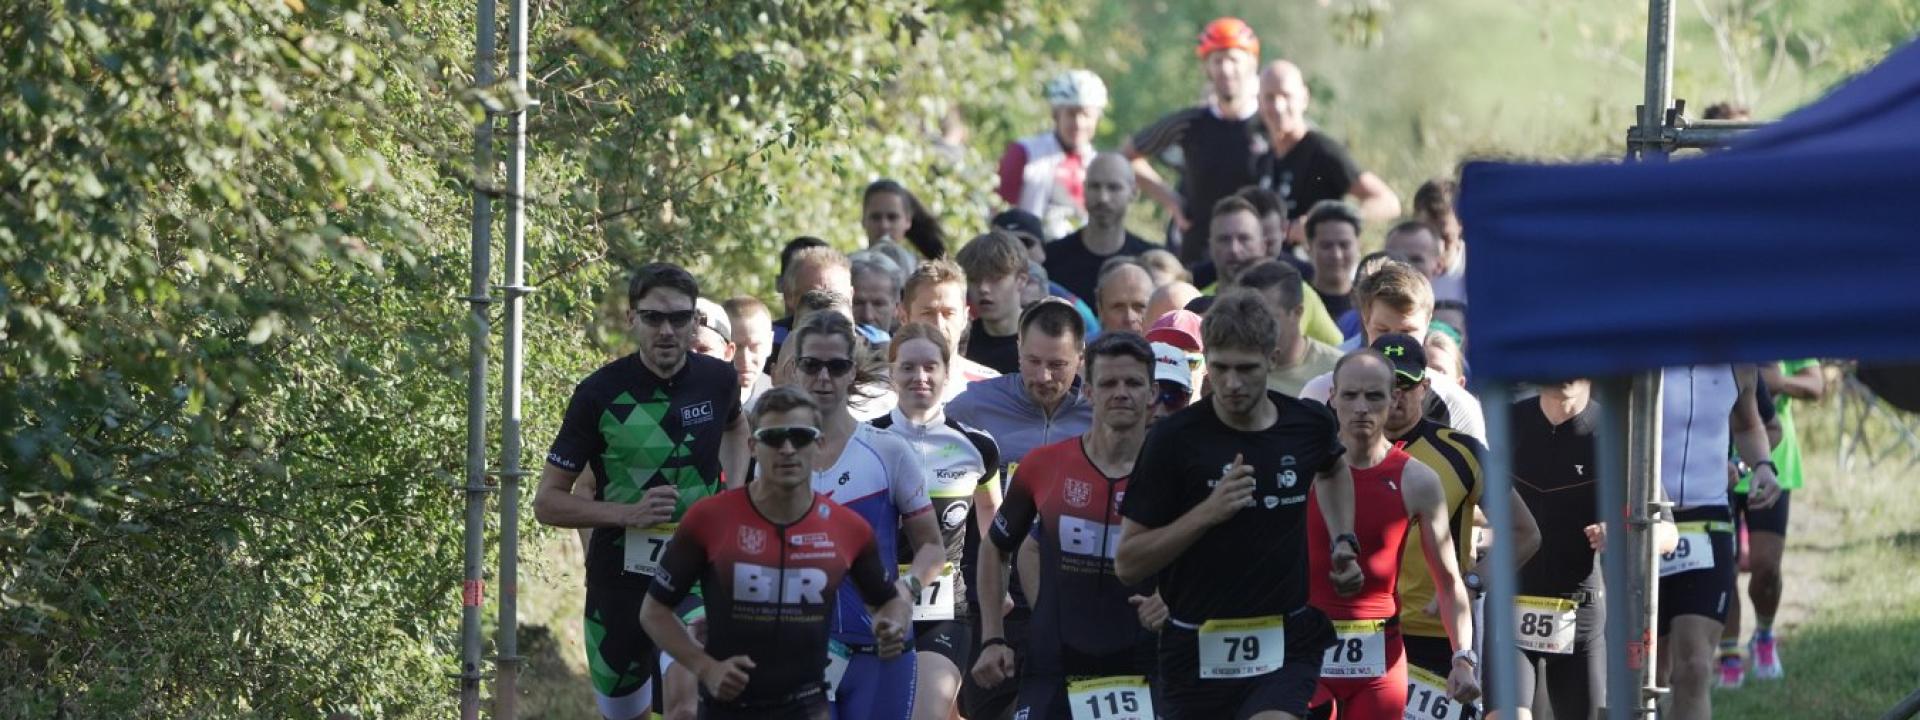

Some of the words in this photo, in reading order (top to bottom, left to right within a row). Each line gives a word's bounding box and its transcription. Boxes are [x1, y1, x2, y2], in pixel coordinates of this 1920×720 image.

[1521, 612, 1554, 637] 85
[1223, 635, 1260, 662] 79
[1332, 638, 1363, 663] 78
[1086, 690, 1139, 719] 115
